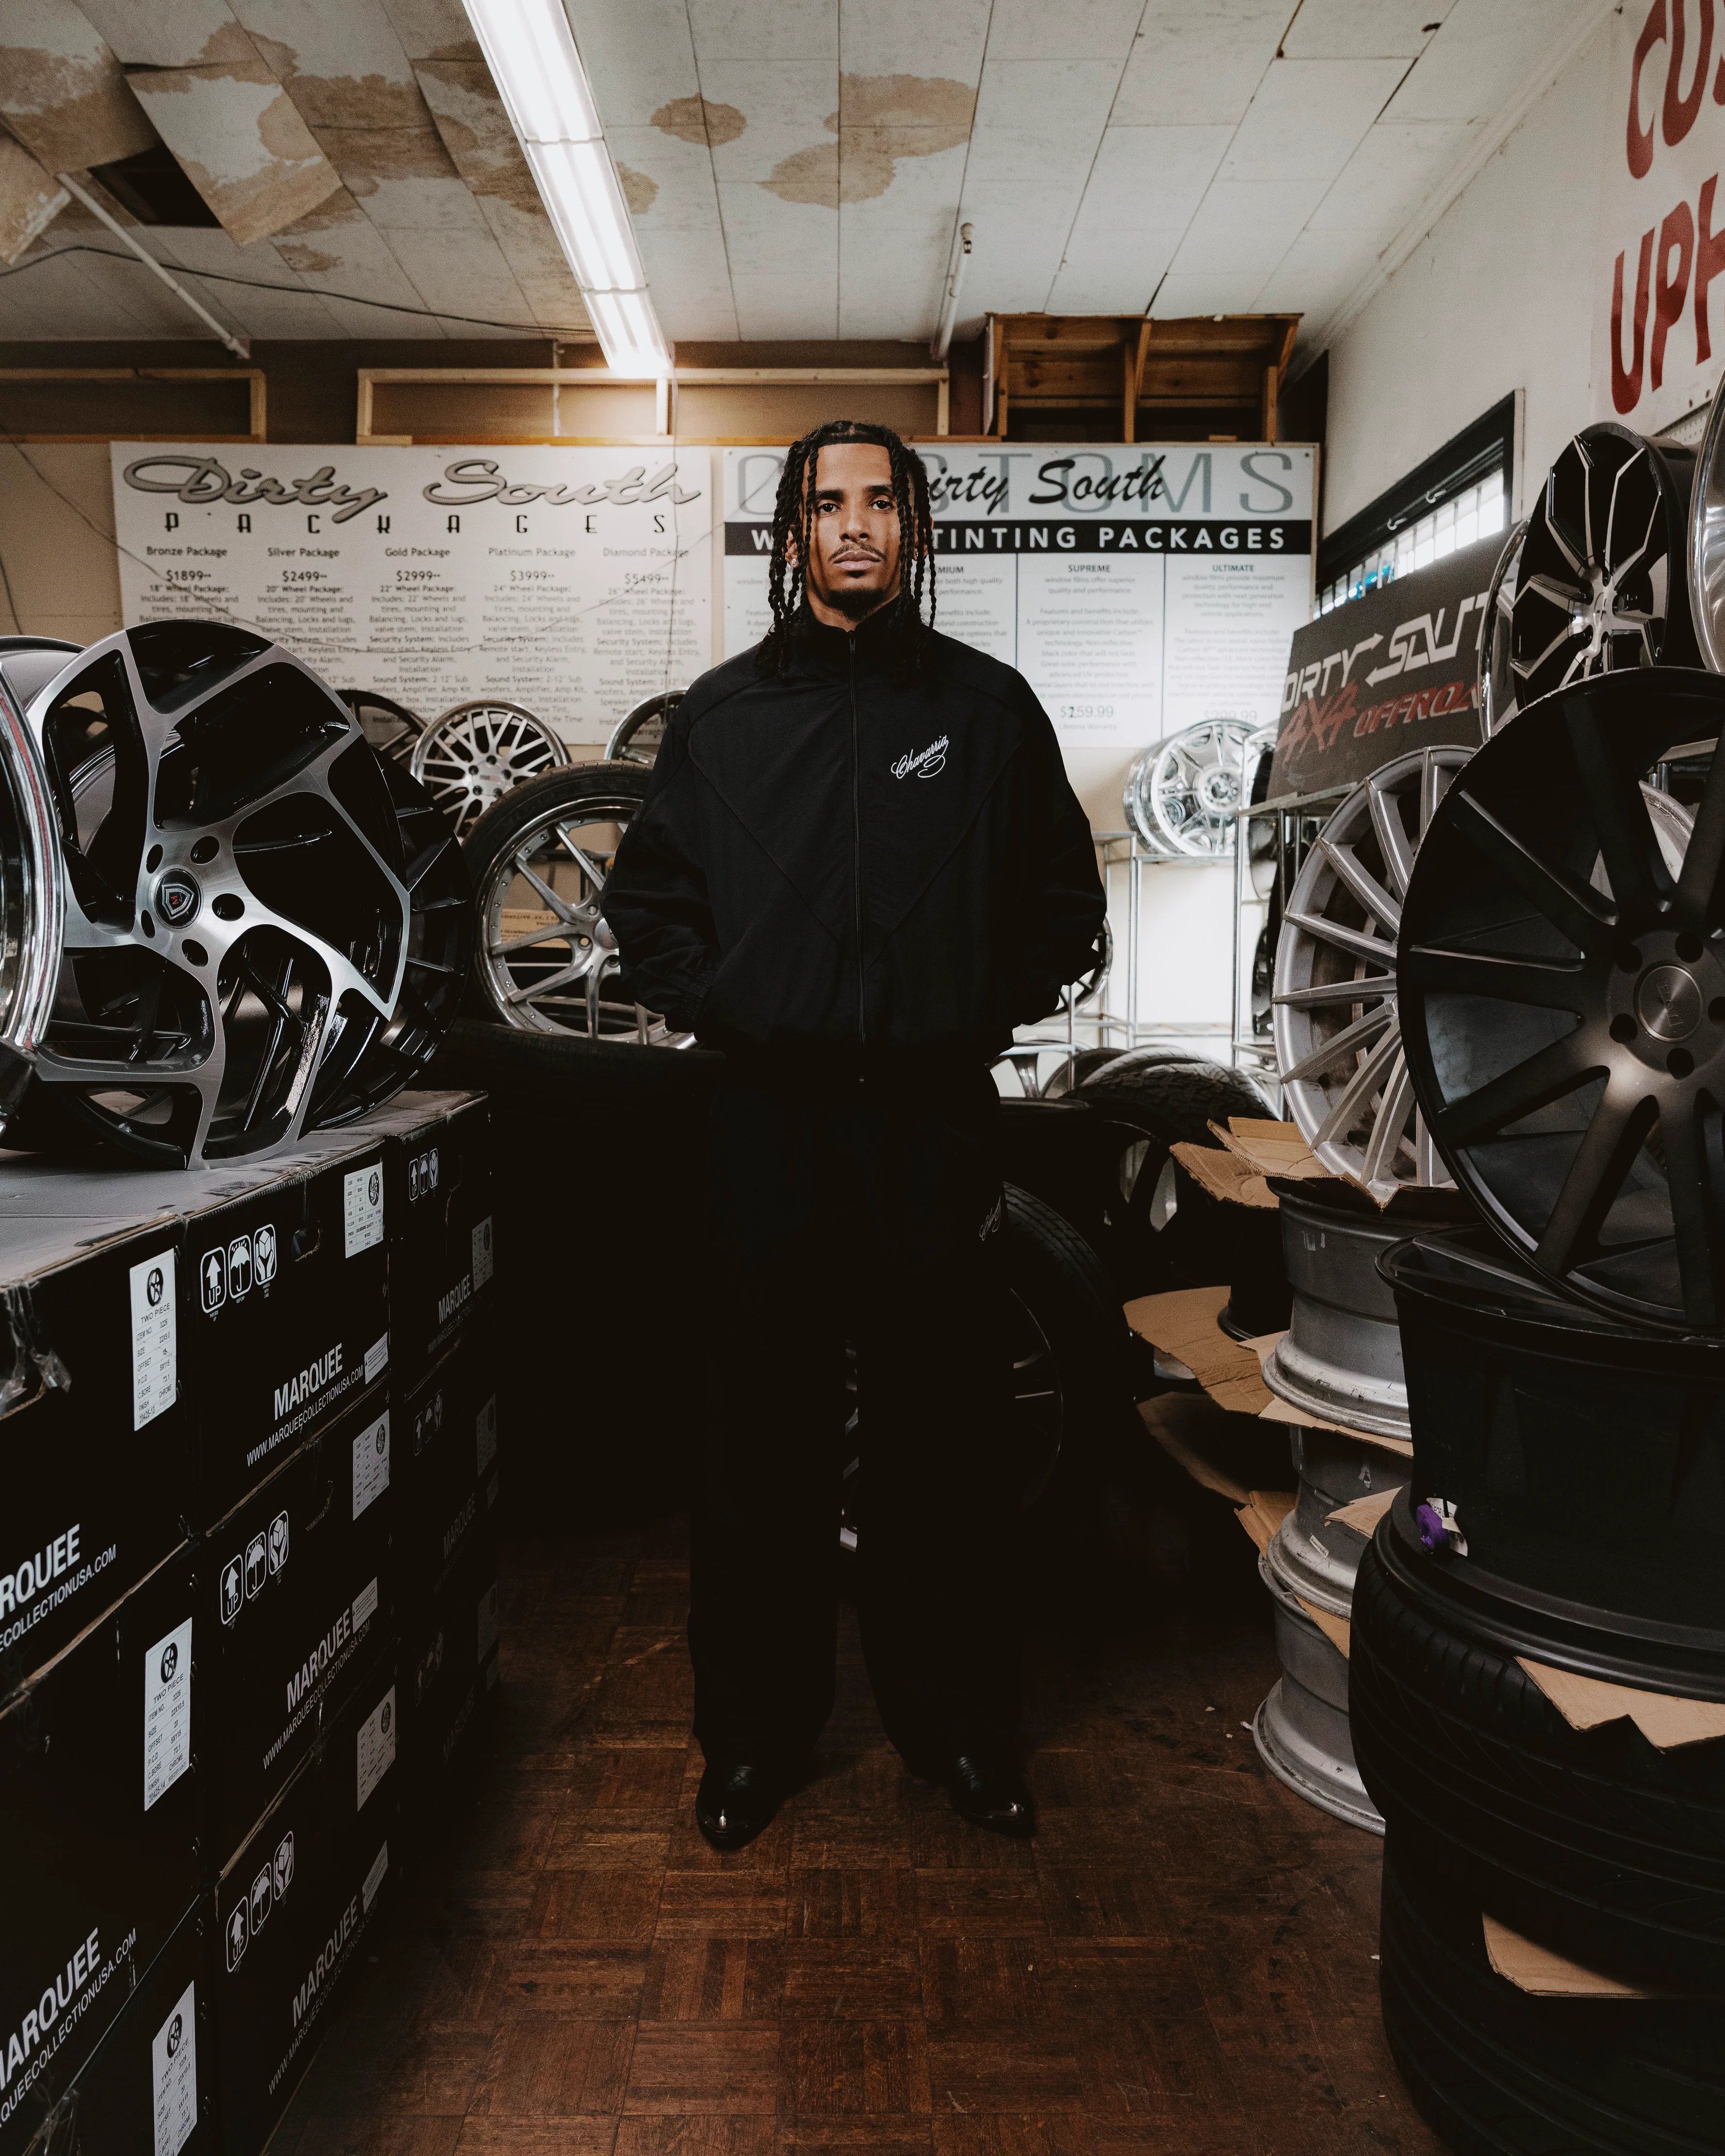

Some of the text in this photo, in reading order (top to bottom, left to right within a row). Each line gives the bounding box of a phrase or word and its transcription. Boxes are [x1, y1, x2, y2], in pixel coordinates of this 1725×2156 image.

[1627, 0, 1725, 179] CU
[123, 455, 701, 524] Dirty South
[929, 455, 1166, 516] irty South
[932, 527, 1285, 549] TINTING PACKAGES
[146, 547, 227, 557] Bronze Package
[267, 547, 340, 557] Silver Package
[385, 548, 451, 558] Gold Package
[488, 548, 576, 558] Platinum Package
[603, 548, 690, 558] Diamond Package
[1068, 564, 1111, 573] SUPREME
[1212, 564, 1255, 572] ULTIMATE
[1281, 633, 1384, 713] DIRTY
[1365, 592, 1490, 687] SOUT
[1353, 681, 1479, 738] OFFROA
[209, 1285, 221, 1305] UP
[439, 1274, 471, 1324] MARQUEE
[141, 1302, 170, 1324] TWO PIECE
[136, 1331, 145, 1342] ITEM
[137, 1358, 152, 1372] OFFSET
[160, 1359, 170, 1371] 5X115
[138, 1385, 151, 1399] C.BORE
[275, 1343, 343, 1421] MARQUEE
[138, 1384, 172, 1412] FINISH CHROME
[247, 1365, 363, 1467] WWW.MARQUEECOLLECTIONUSA.COM
[227, 1593, 238, 1615] UP
[287, 1608, 350, 1713] MARQUEE
[153, 1673, 184, 1704] TWO PIECE
[263, 1619, 370, 1769] WWW.MARQUEECOLLECTIONUSA.COM
[148, 1710, 158, 1722] ITEM
[172, 1689, 181, 1701] 3226
[148, 1700, 185, 1738] SIZE 22X10.5
[148, 1719, 178, 1752] OFFSET 20
[171, 1729, 181, 1744] 5X115
[148, 1762, 162, 1779] C.BORE
[148, 1753, 183, 1792] FINISH CHROME
[149, 1781, 165, 1803] 20425-14
[233, 1935, 244, 1961] UP
[293, 1894, 358, 2029] MARQUEE
[0, 1928, 136, 2128] QUEECOLLECTIONUSA.COM
[161, 2036, 189, 2083] TWO PIECE
[178, 2062, 190, 2085] 22X10.5
[157, 2086, 166, 2105] ITEM
[178, 2092, 188, 2110] 5X115
[158, 2085, 185, 2132] OFFSET 20
[177, 2112, 191, 2138] CHROME
[158, 2135, 171, 2156] C.BORE
